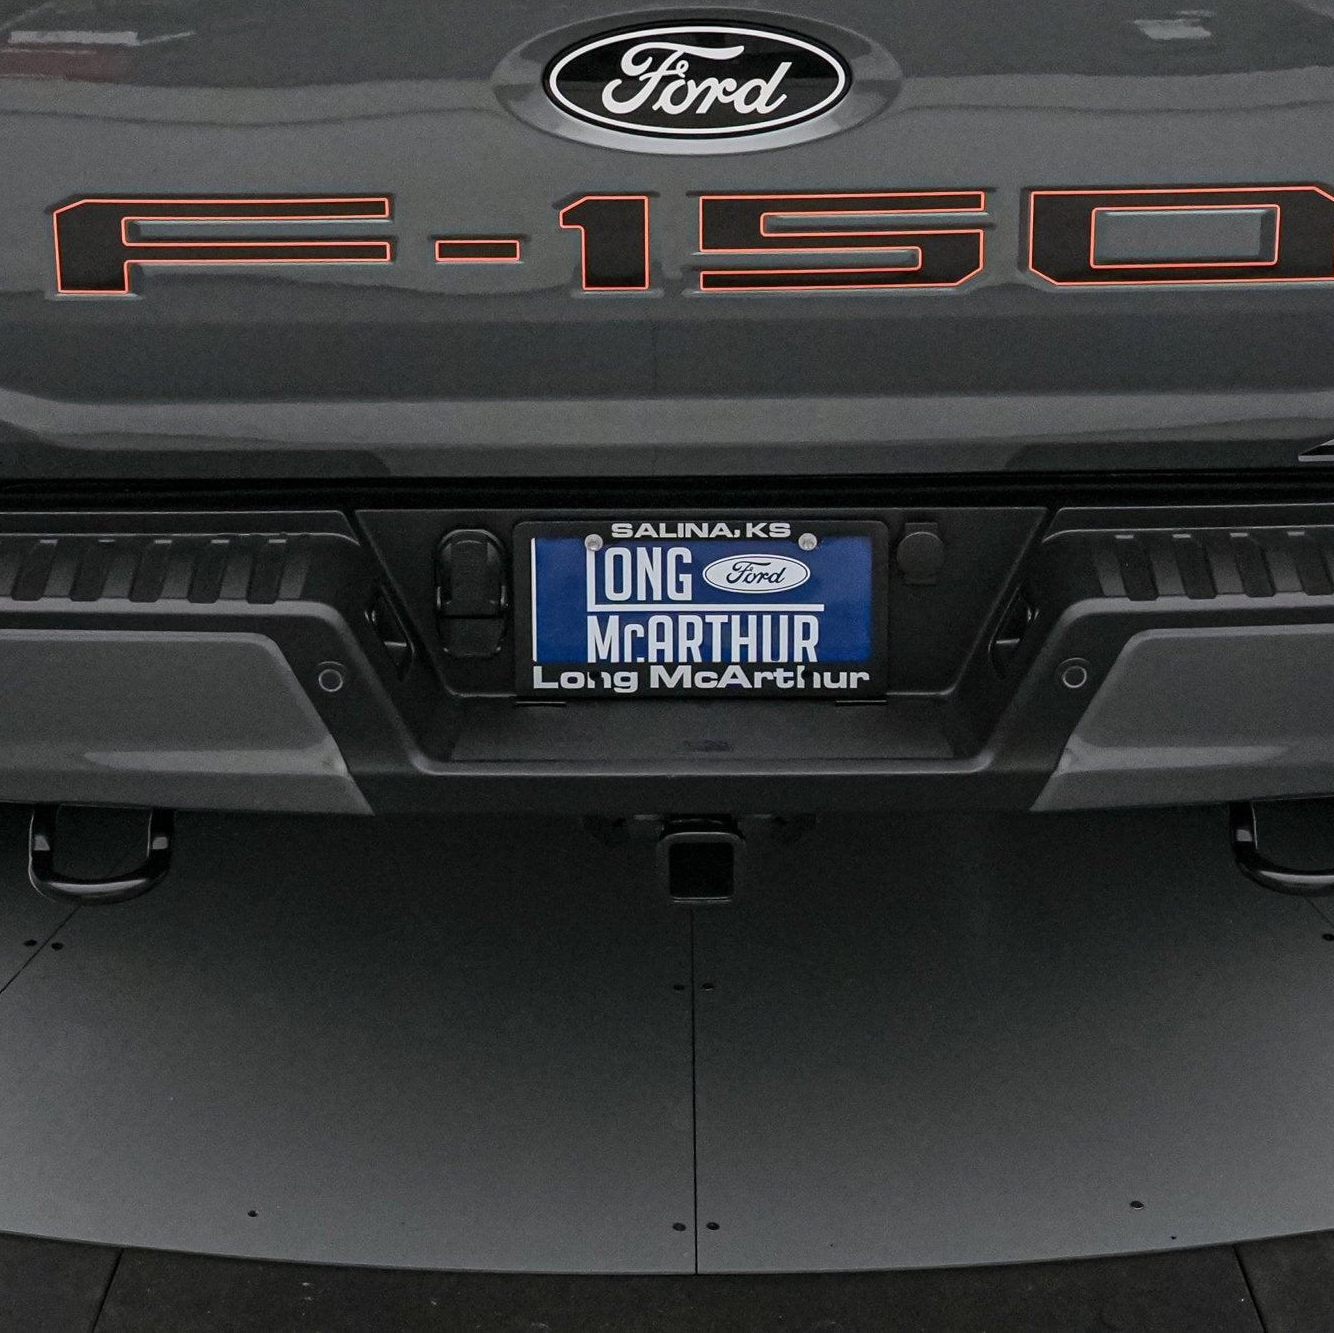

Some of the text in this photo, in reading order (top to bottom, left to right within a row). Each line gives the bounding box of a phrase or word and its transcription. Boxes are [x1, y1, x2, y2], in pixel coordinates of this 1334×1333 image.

[602, 42, 792, 114] Ford
[746, 522, 792, 538] KS
[586, 546, 693, 612] LONG
[587, 615, 820, 663] McARTHUR
[533, 665, 870, 693] Long McArthur
